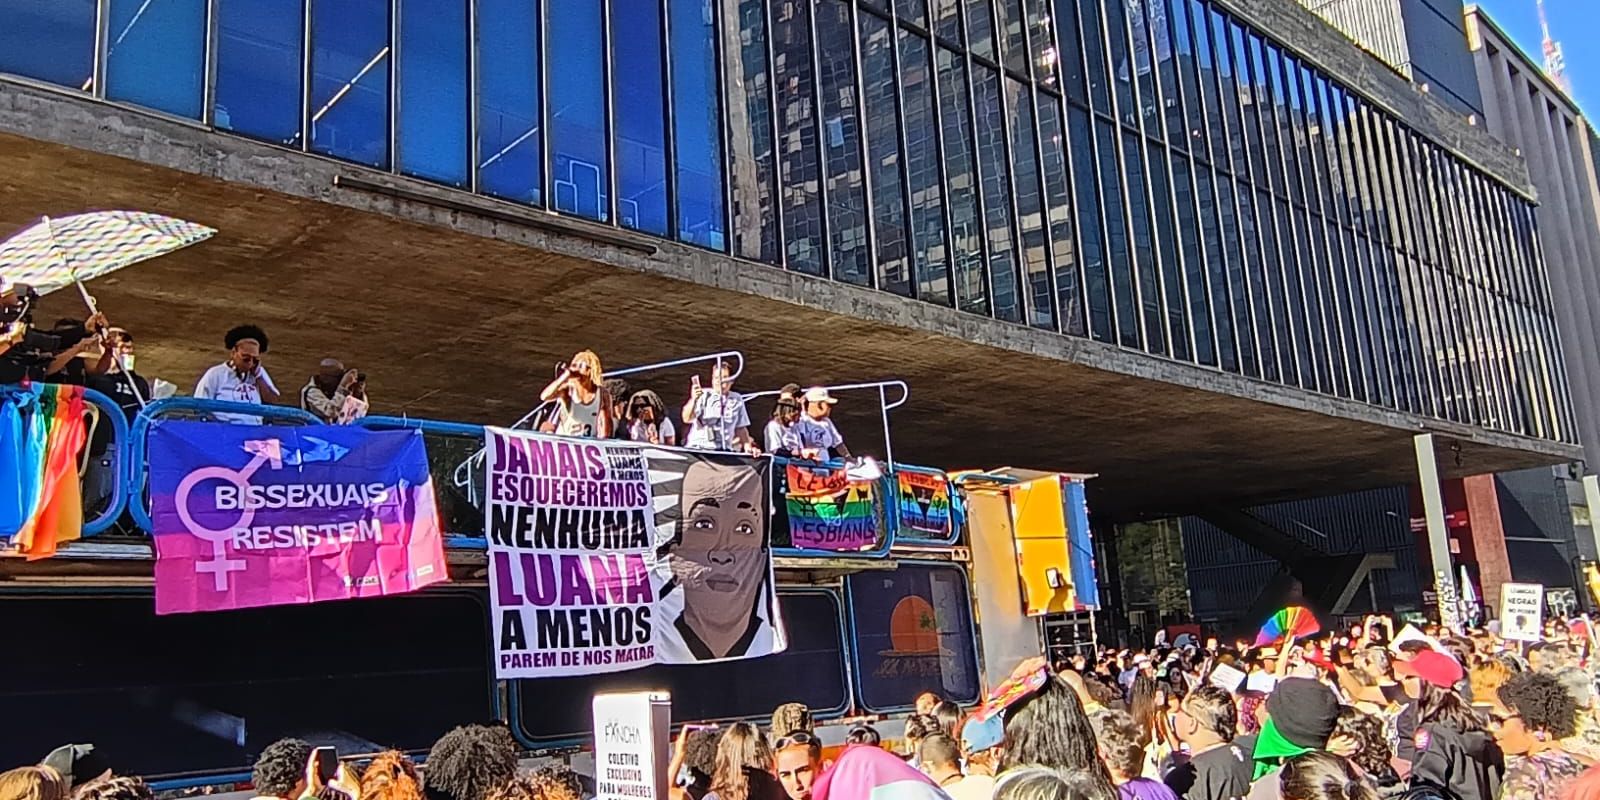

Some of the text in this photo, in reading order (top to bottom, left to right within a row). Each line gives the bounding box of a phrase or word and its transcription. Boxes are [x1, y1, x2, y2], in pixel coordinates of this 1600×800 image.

[493, 433, 607, 480] JAMAIS
[608, 456, 642, 469] LUANA
[611, 469, 645, 481] A MENOS
[215, 482, 388, 510] BISSEXUAIS
[491, 473, 648, 507] ESQUECEREMOS
[232, 518, 383, 550] RESISTEM
[490, 504, 649, 550] NENHUMA
[494, 552, 654, 607] LUANA
[1508, 597, 1537, 605] NEGRAS
[500, 606, 652, 650] A MENOS
[500, 645, 655, 669] PAREM DE NOS MATAR
[608, 753, 639, 766] COLETIVO
[606, 768, 642, 782] EXCLUSIVO
[599, 782, 652, 798] PARA MULHERES
